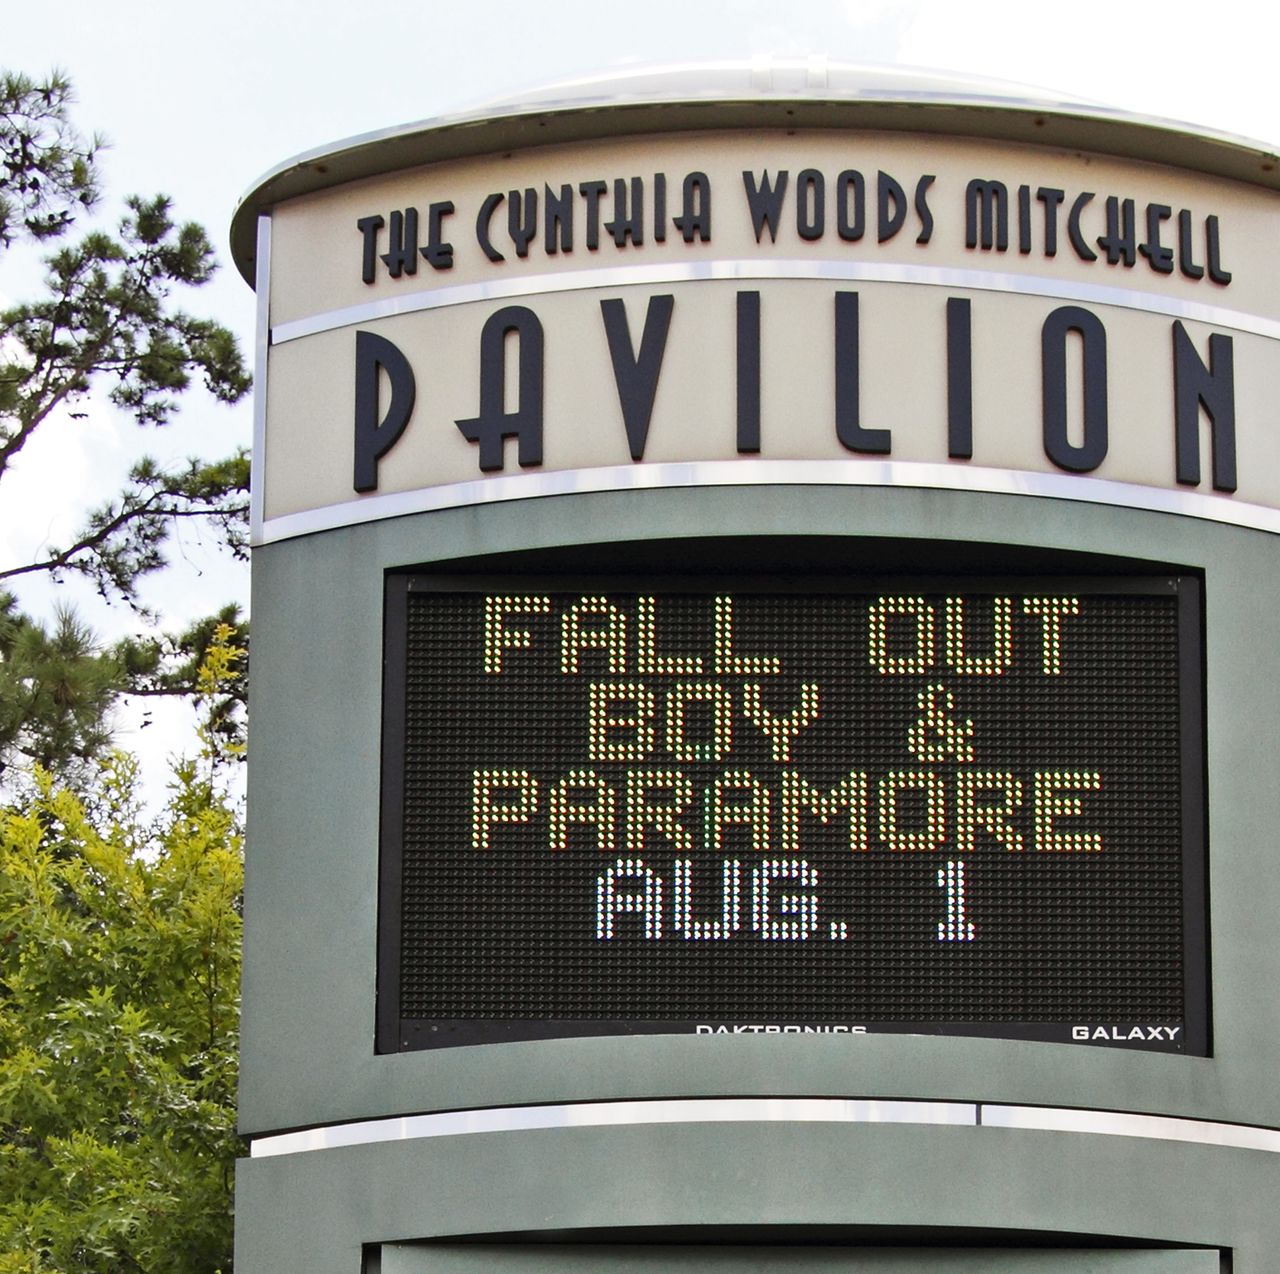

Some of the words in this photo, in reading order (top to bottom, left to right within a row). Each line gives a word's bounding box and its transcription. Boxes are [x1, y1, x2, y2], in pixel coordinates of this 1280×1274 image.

[358, 200, 454, 284] THE
[476, 170, 712, 261] CYNTHIA
[742, 167, 936, 244] WOODS
[965, 177, 1233, 285] MITCHELL
[352, 290, 1238, 492] PAVILION
[483, 595, 780, 674] FALL
[868, 595, 1080, 675] OUT
[588, 683, 819, 762] BOY
[907, 684, 975, 762] &
[471, 769, 1103, 851] PARAMORE
[595, 858, 848, 941] AUG.
[936, 860, 975, 941] 1
[1072, 1026, 1180, 1040] GALAXY
